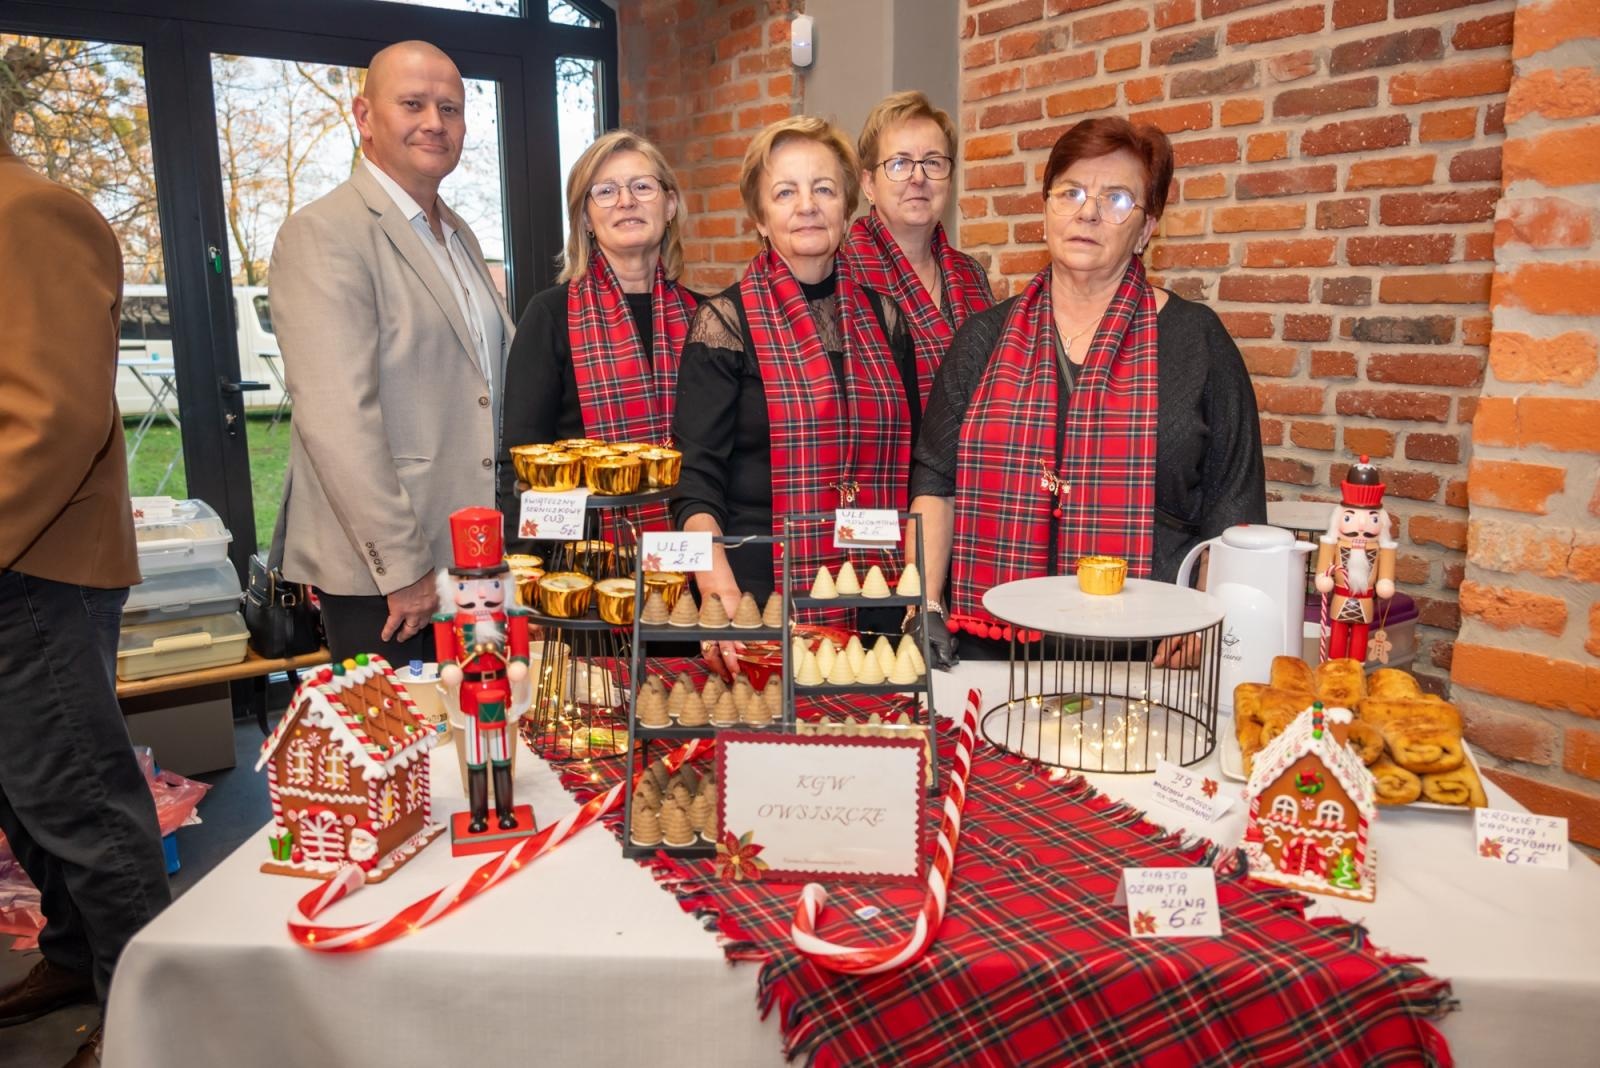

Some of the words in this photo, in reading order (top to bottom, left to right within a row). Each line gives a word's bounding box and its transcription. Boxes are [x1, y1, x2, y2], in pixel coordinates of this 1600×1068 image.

[842, 511, 866, 519] ULE
[657, 540, 689, 552] ULE
[673, 552, 685, 565] 2
[796, 775, 856, 797] KGW
[1480, 811, 1545, 826] KROKIET
[1498, 835, 1562, 852] GRZYBAMI
[1505, 847, 1520, 864] 6
[1141, 870, 1188, 880] CIASTO
[1169, 908, 1186, 928] 6
